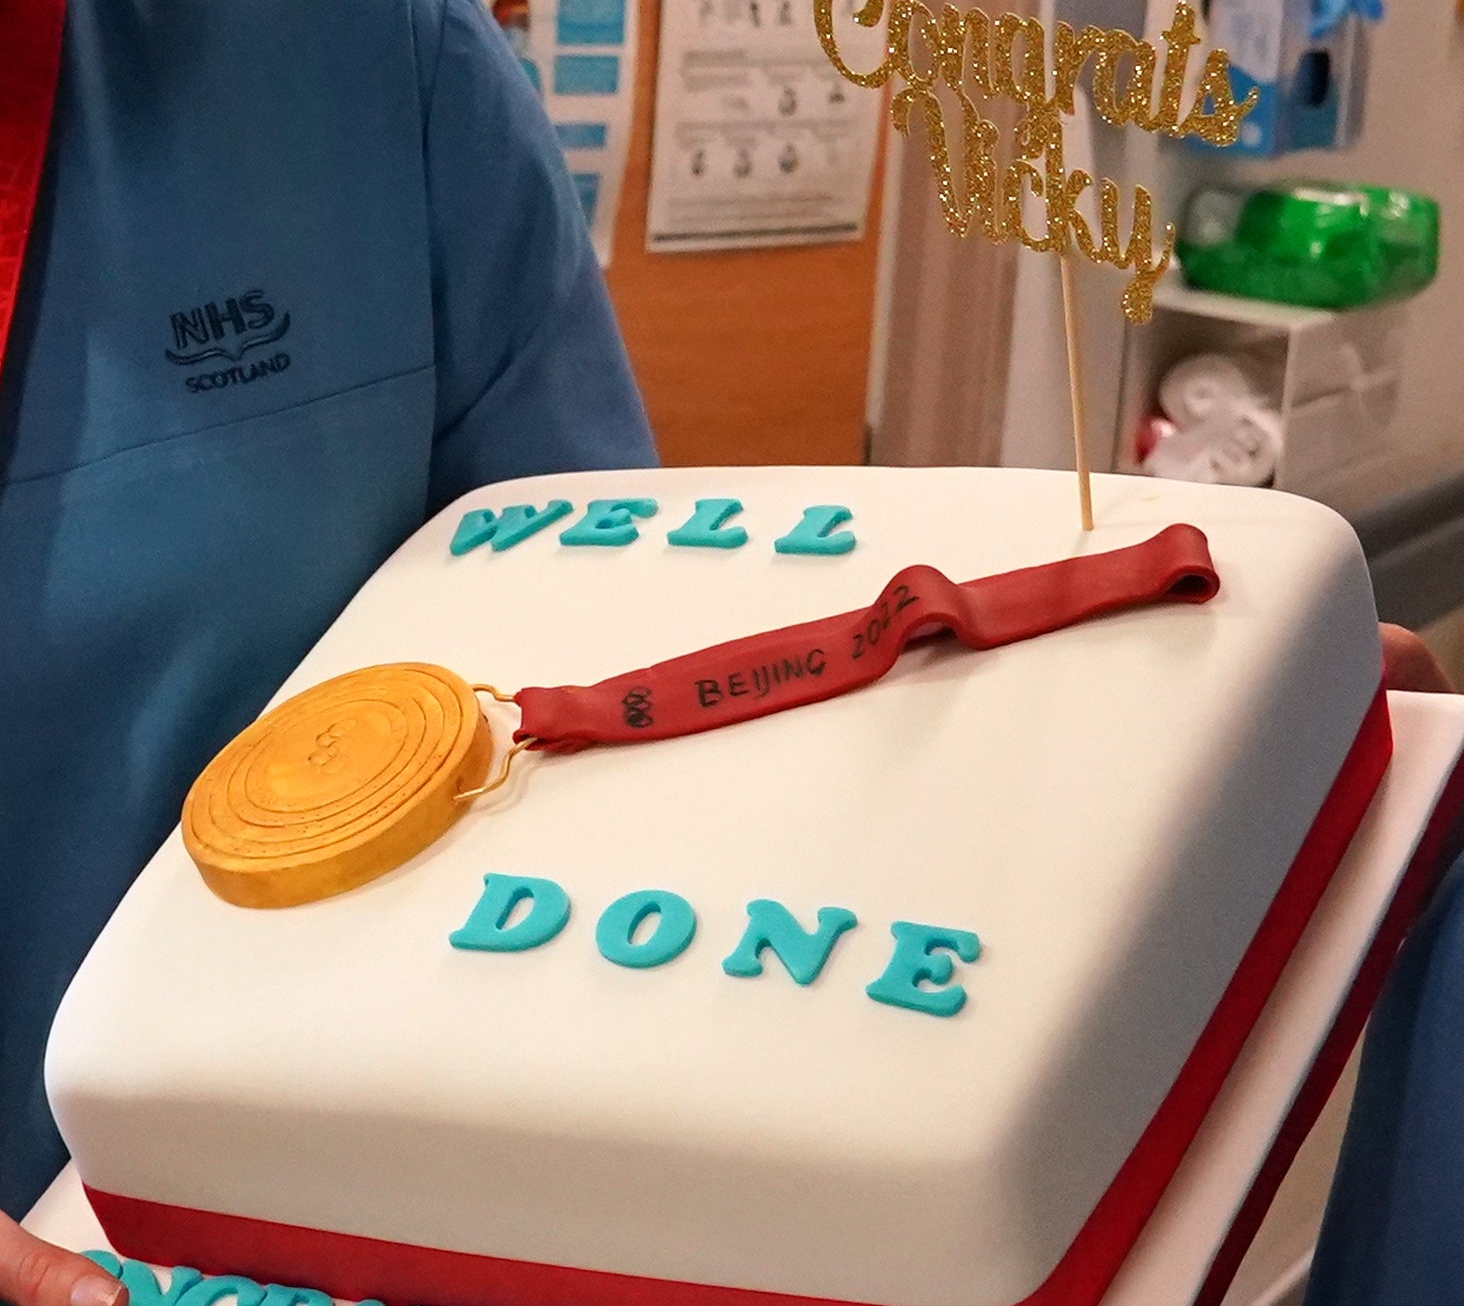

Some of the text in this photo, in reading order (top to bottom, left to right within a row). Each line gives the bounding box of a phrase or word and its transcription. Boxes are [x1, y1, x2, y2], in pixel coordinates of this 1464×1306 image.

[890, 86, 1176, 326] Vicky
[169, 289, 277, 350] NHS
[185, 352, 292, 394] SCOTLAND
[449, 498, 858, 557] WELL
[694, 584, 921, 709] BEIJING 2022
[448, 871, 983, 1018] DONE
